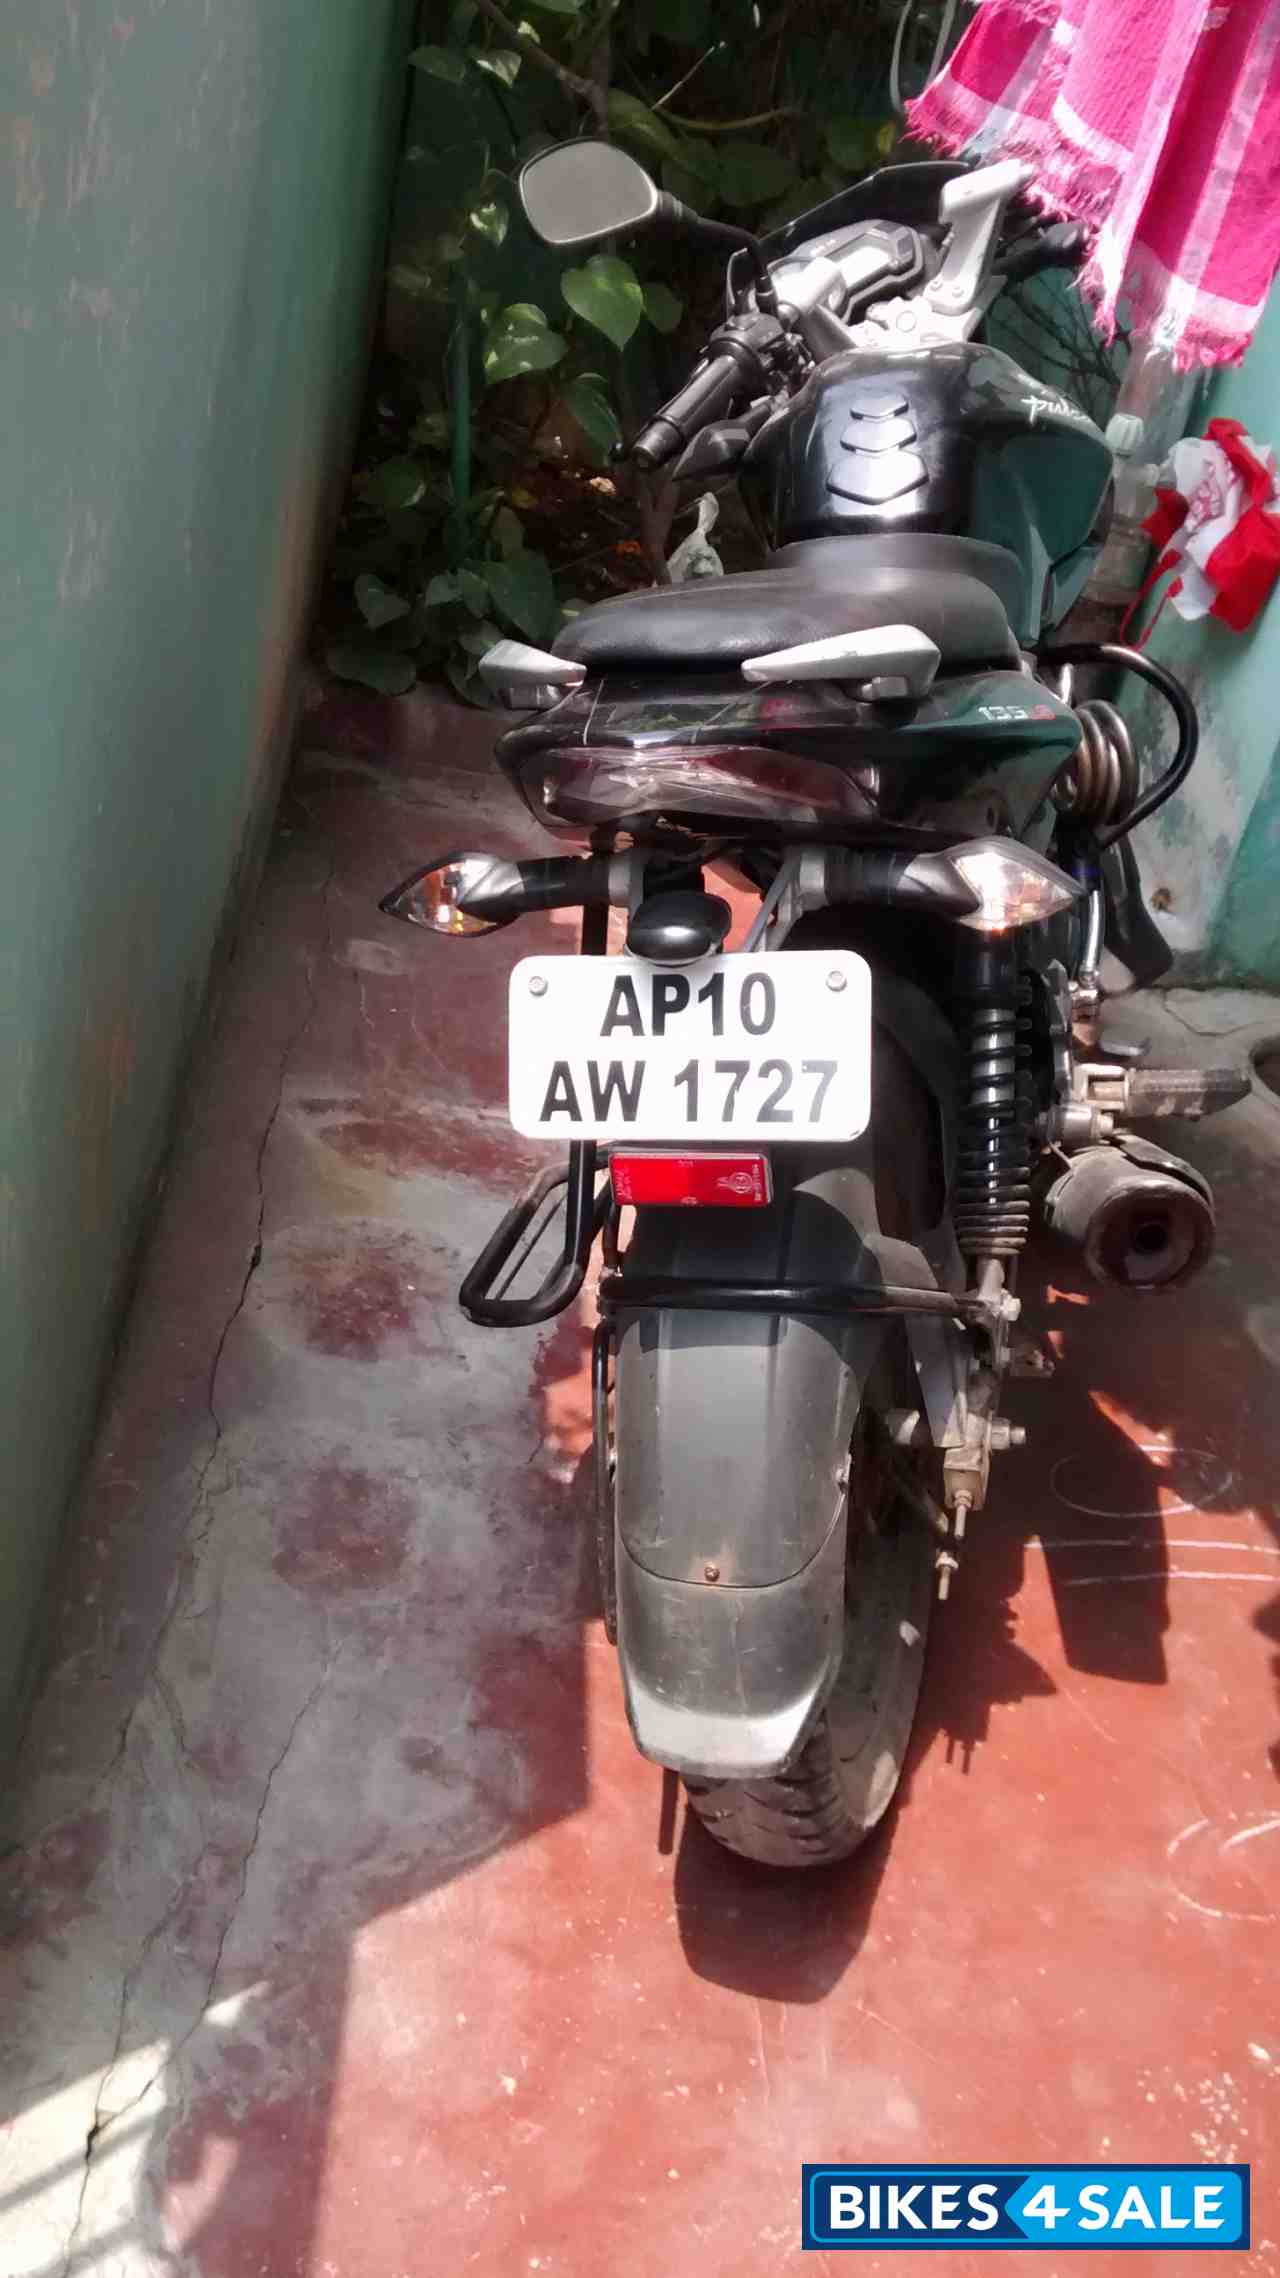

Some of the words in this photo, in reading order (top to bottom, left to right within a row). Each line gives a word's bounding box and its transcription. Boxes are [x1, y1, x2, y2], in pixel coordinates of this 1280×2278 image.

[600, 972, 776, 1036] AP10
[539, 1060, 646, 1122] AW
[674, 1059, 838, 1122] 1727
